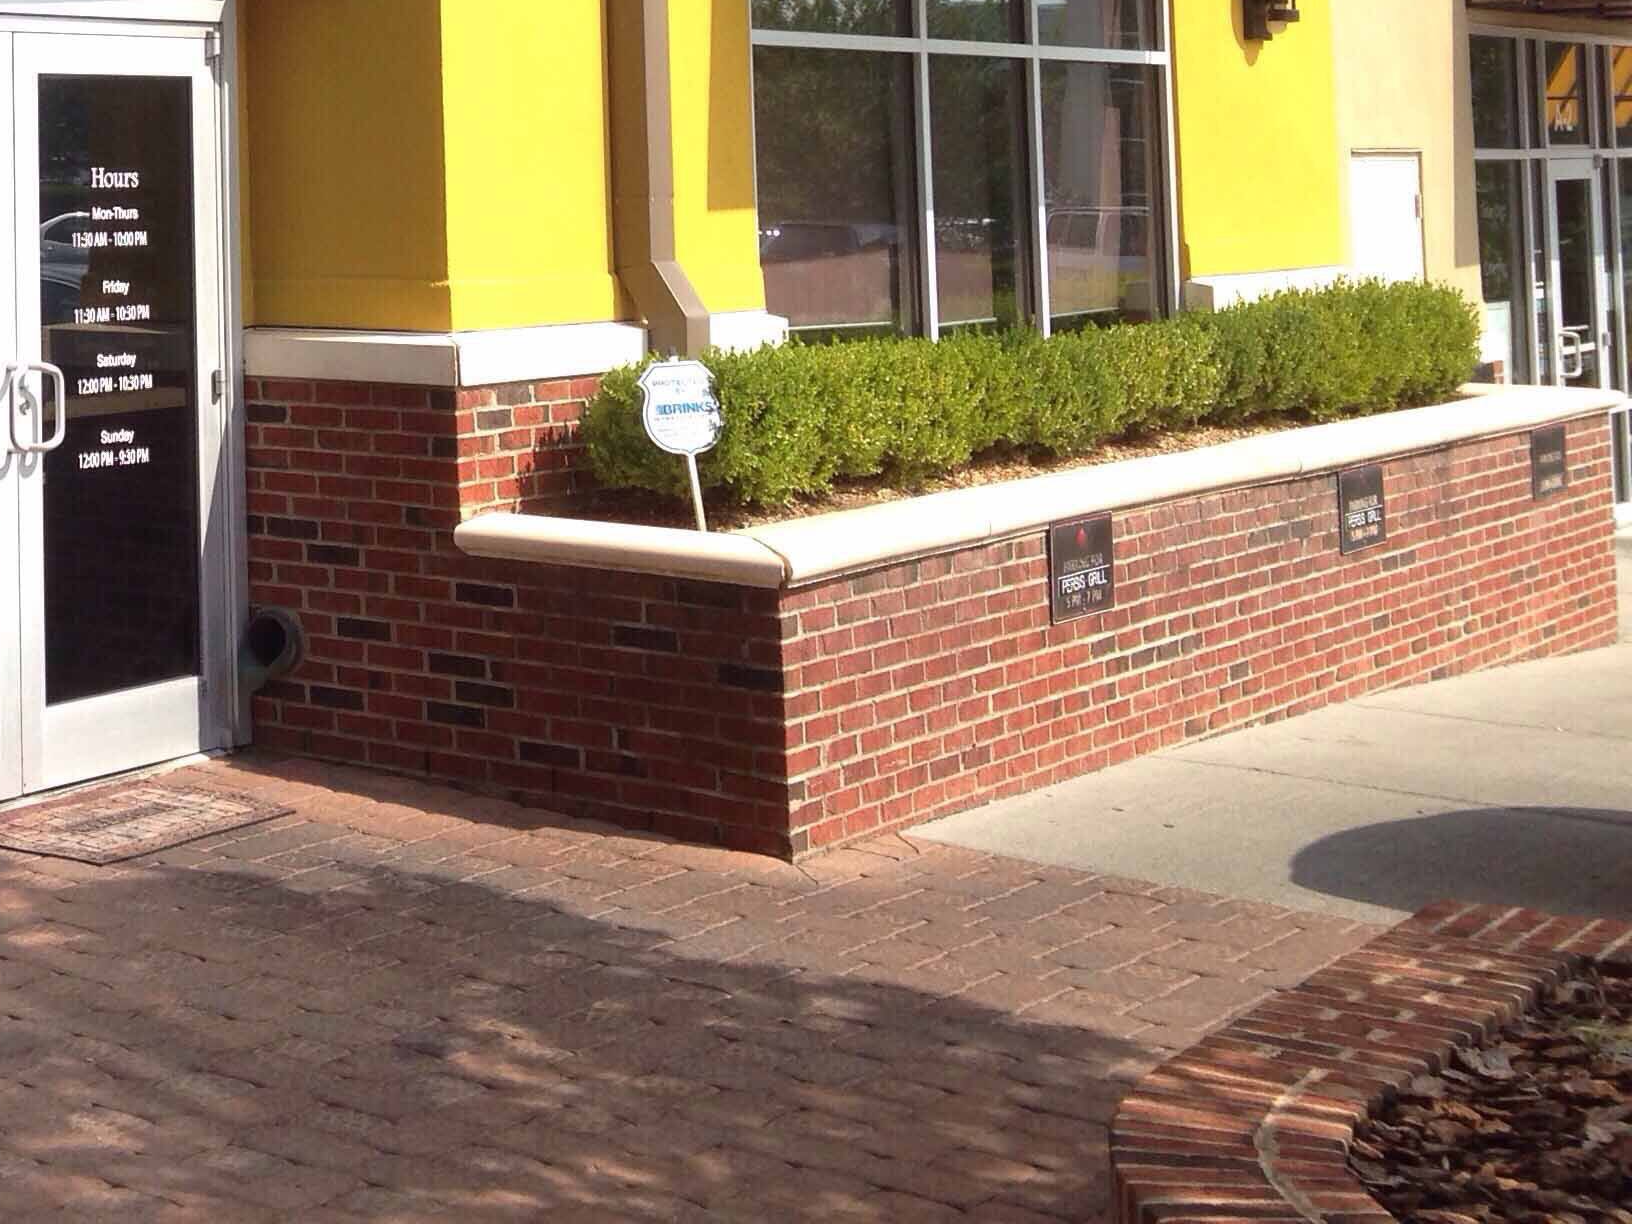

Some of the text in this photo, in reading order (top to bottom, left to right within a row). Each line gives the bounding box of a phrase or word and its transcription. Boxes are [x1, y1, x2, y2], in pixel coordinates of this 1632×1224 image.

[91, 167, 139, 188] Hours
[92, 206, 139, 220] Mon-Thurs
[72, 232, 93, 248] 11:30
[94, 232, 108, 247] AM
[113, 231, 134, 247] 10:00
[134, 231, 148, 246] PM
[102, 280, 130, 295] Friday
[74, 308, 95, 324] 11:30
[96, 307, 110, 323] AM
[115, 305, 136, 321] 10:30
[137, 304, 150, 320] PM
[96, 352, 136, 368] Saturday
[77, 378, 99, 394] 12:00
[99, 376, 113, 393] PM
[118, 375, 139, 391] 10:30
[140, 374, 153, 389] PM
[663, 401, 713, 416] BRINKS
[100, 428, 134, 444] Sunday
[79, 451, 100, 469] 12:00
[100, 450, 114, 467] PM
[119, 449, 136, 465] 9:30
[136, 448, 149, 463] PM
[1088, 568, 1108, 587] GRILL
